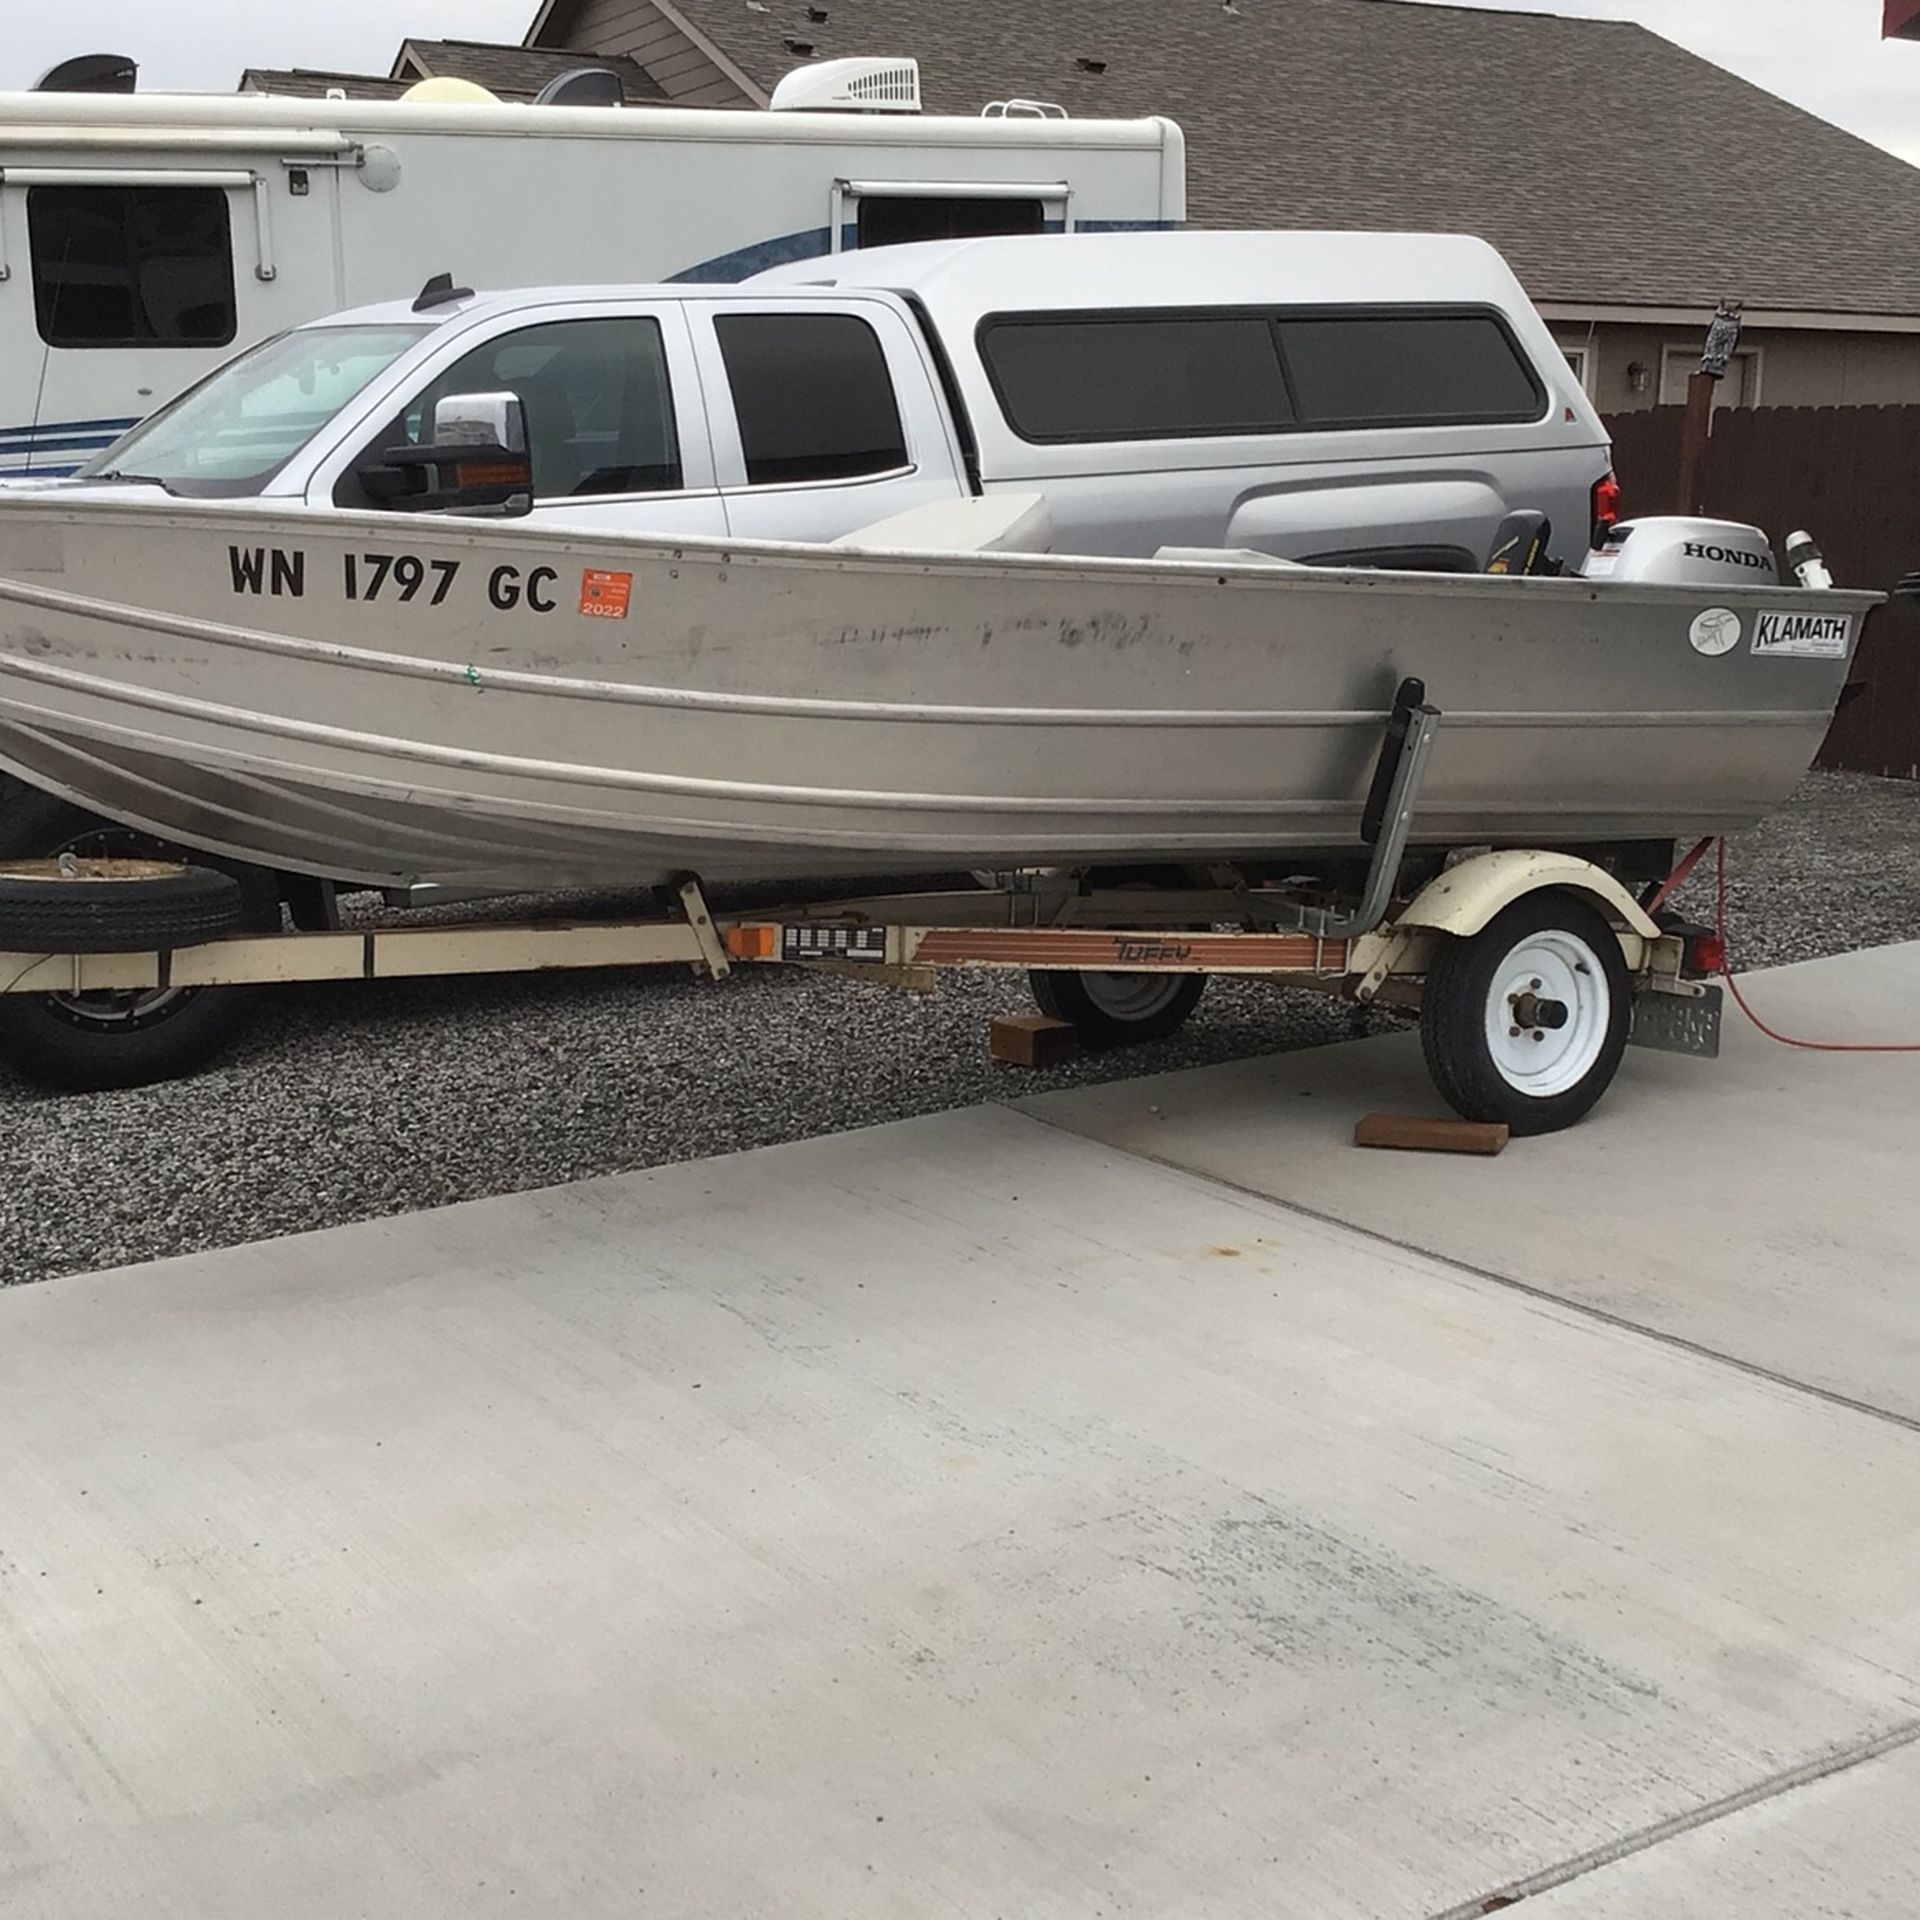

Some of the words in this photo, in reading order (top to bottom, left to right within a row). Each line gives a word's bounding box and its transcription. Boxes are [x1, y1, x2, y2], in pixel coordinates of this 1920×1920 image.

[1683, 542, 1773, 572] HONDA
[229, 545, 304, 597] WN
[344, 553, 461, 605] 1797
[488, 564, 558, 613] GC
[582, 602, 625, 618] 2022
[1756, 615, 1846, 648] KLAMATH
